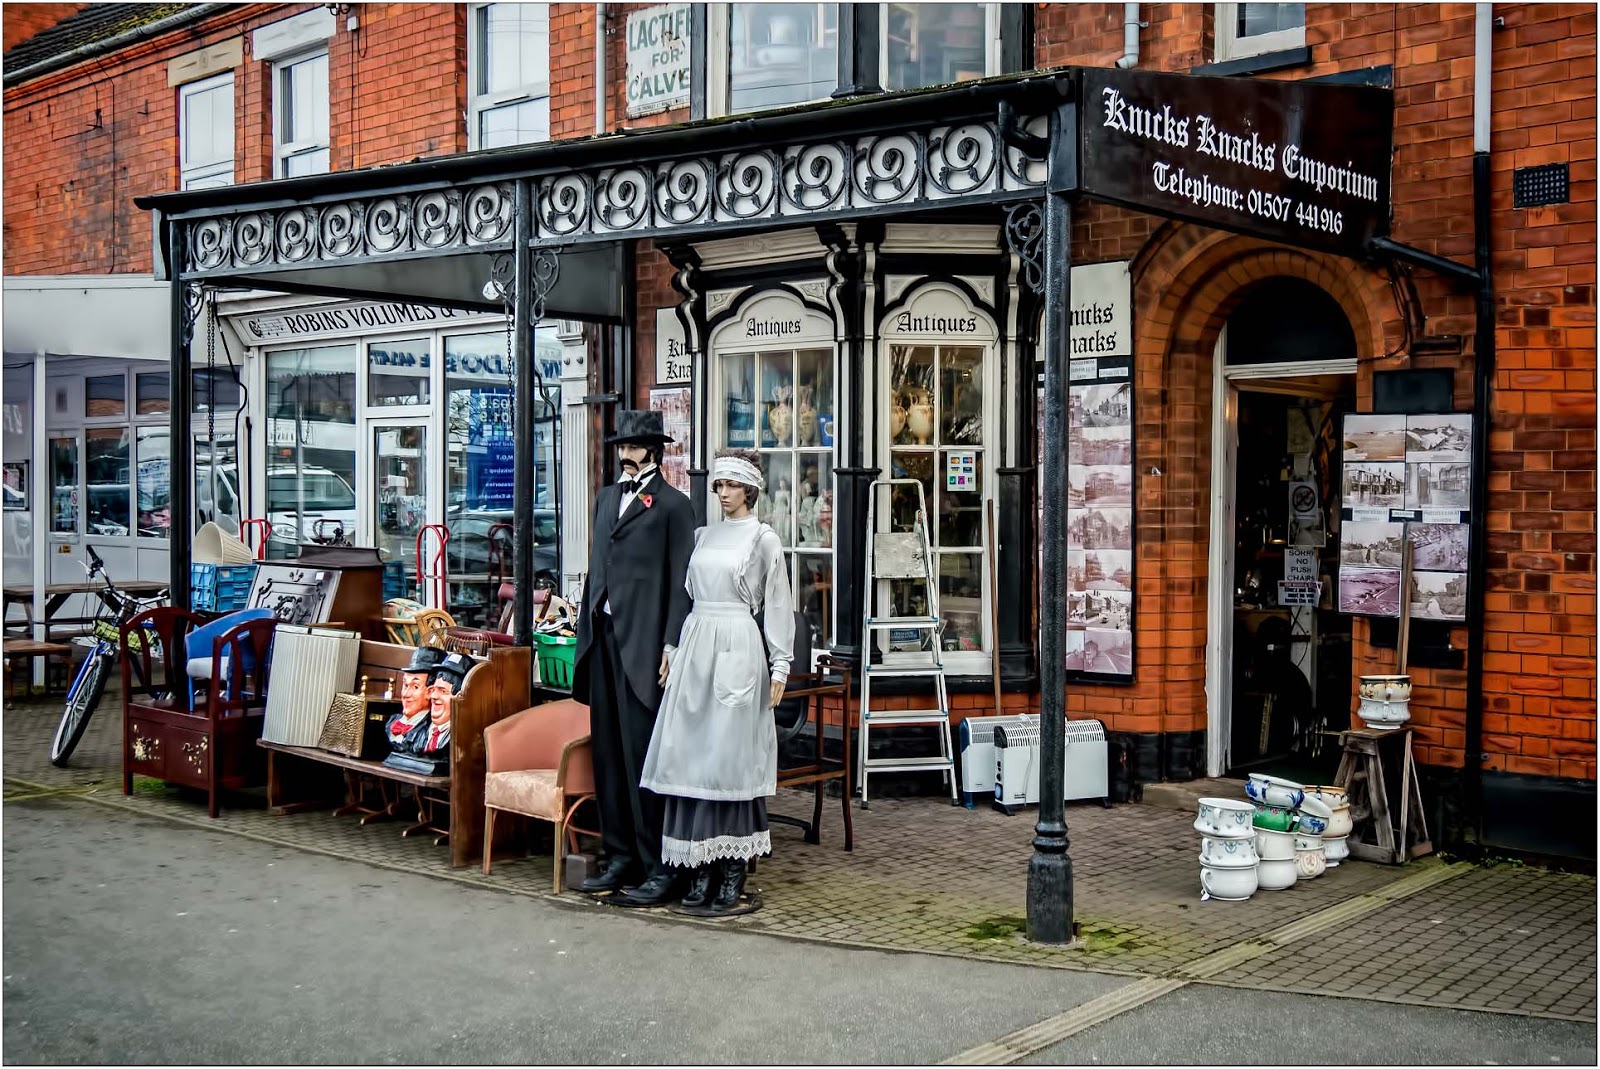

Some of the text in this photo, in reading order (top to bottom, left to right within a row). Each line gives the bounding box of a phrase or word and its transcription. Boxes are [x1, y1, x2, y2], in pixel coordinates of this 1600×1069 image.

[652, 48, 680, 67] FOR
[1102, 87, 1378, 202] Knicks Knacks Emporium
[1152, 161, 1343, 235] Telephone: 01507 441916
[286, 311, 349, 334] ROBINS
[351, 303, 437, 330] VOLUMES
[897, 311, 977, 335] Antiques
[1070, 302, 1114, 327] nicks
[746, 317, 801, 338] Antiques
